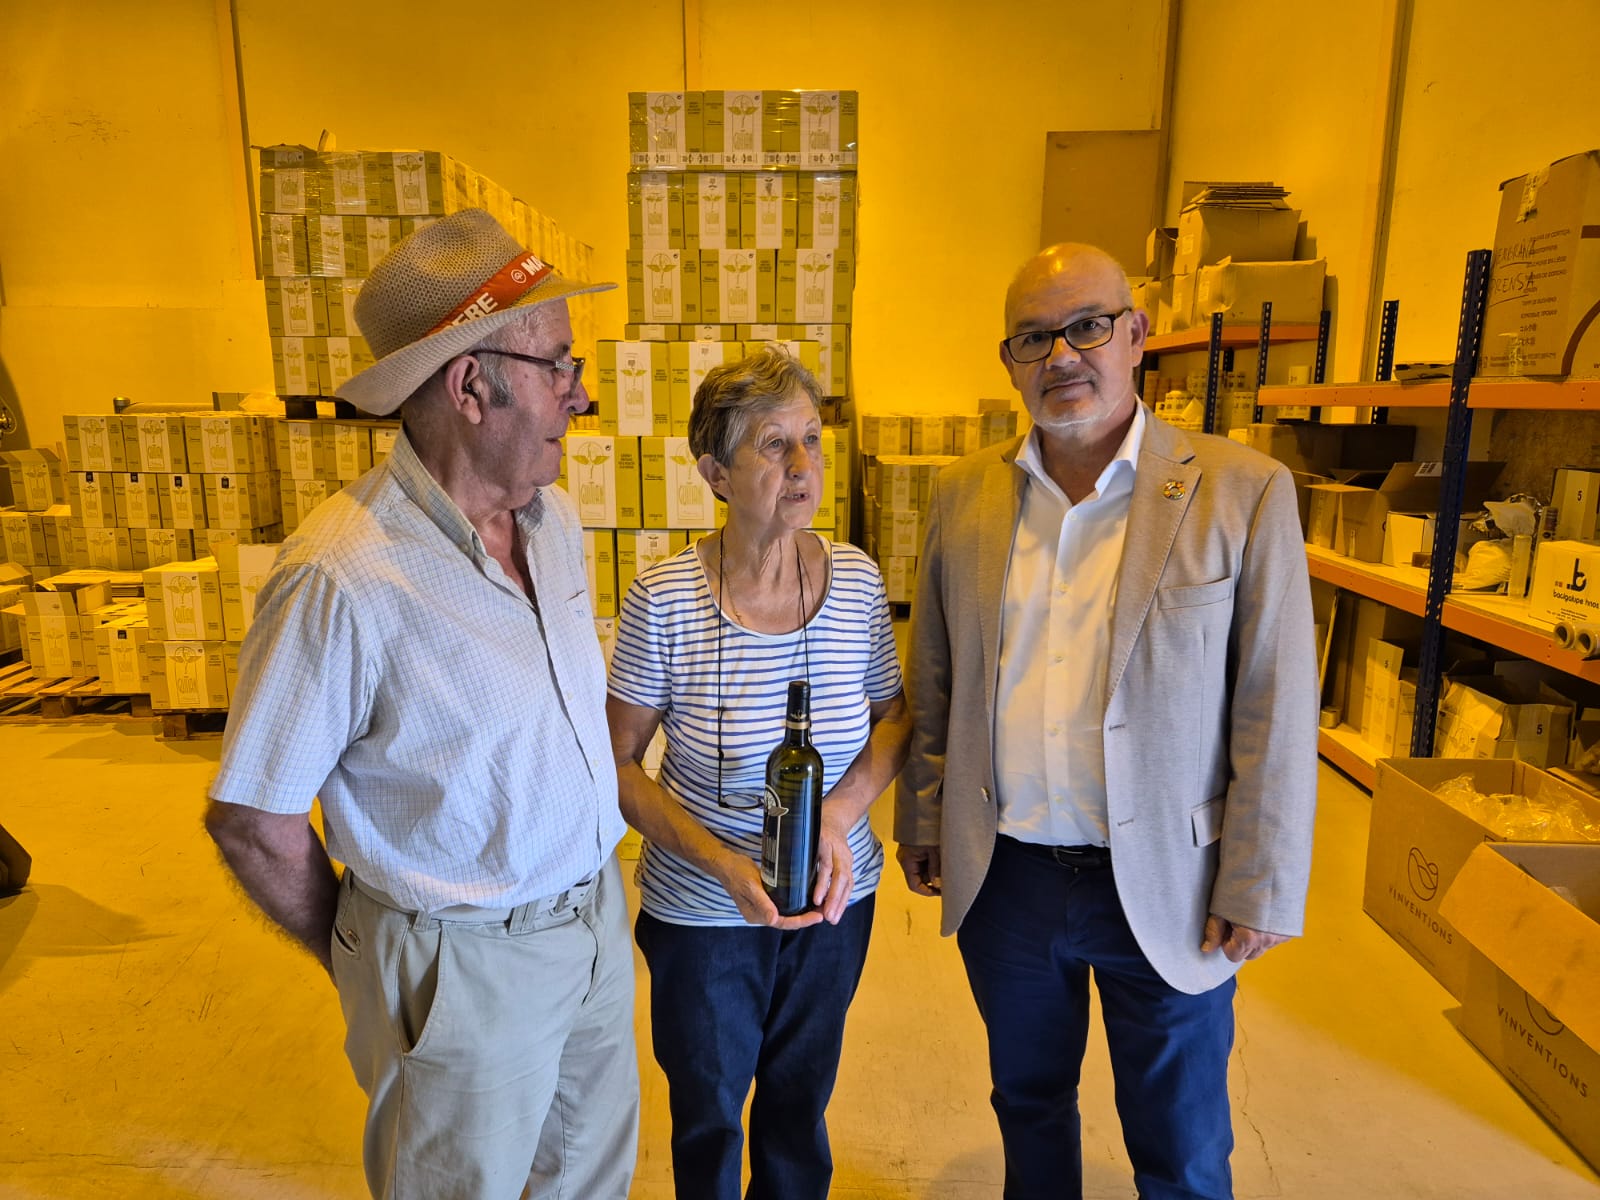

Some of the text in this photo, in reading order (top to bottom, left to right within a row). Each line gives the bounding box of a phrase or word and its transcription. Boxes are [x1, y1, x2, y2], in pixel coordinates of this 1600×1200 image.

[1577, 490, 1583, 501] 5
[1536, 724, 1543, 735] 5
[1389, 885, 1453, 944] VINVENTIONS
[1497, 1004, 1588, 1098] VINVENTIONS
